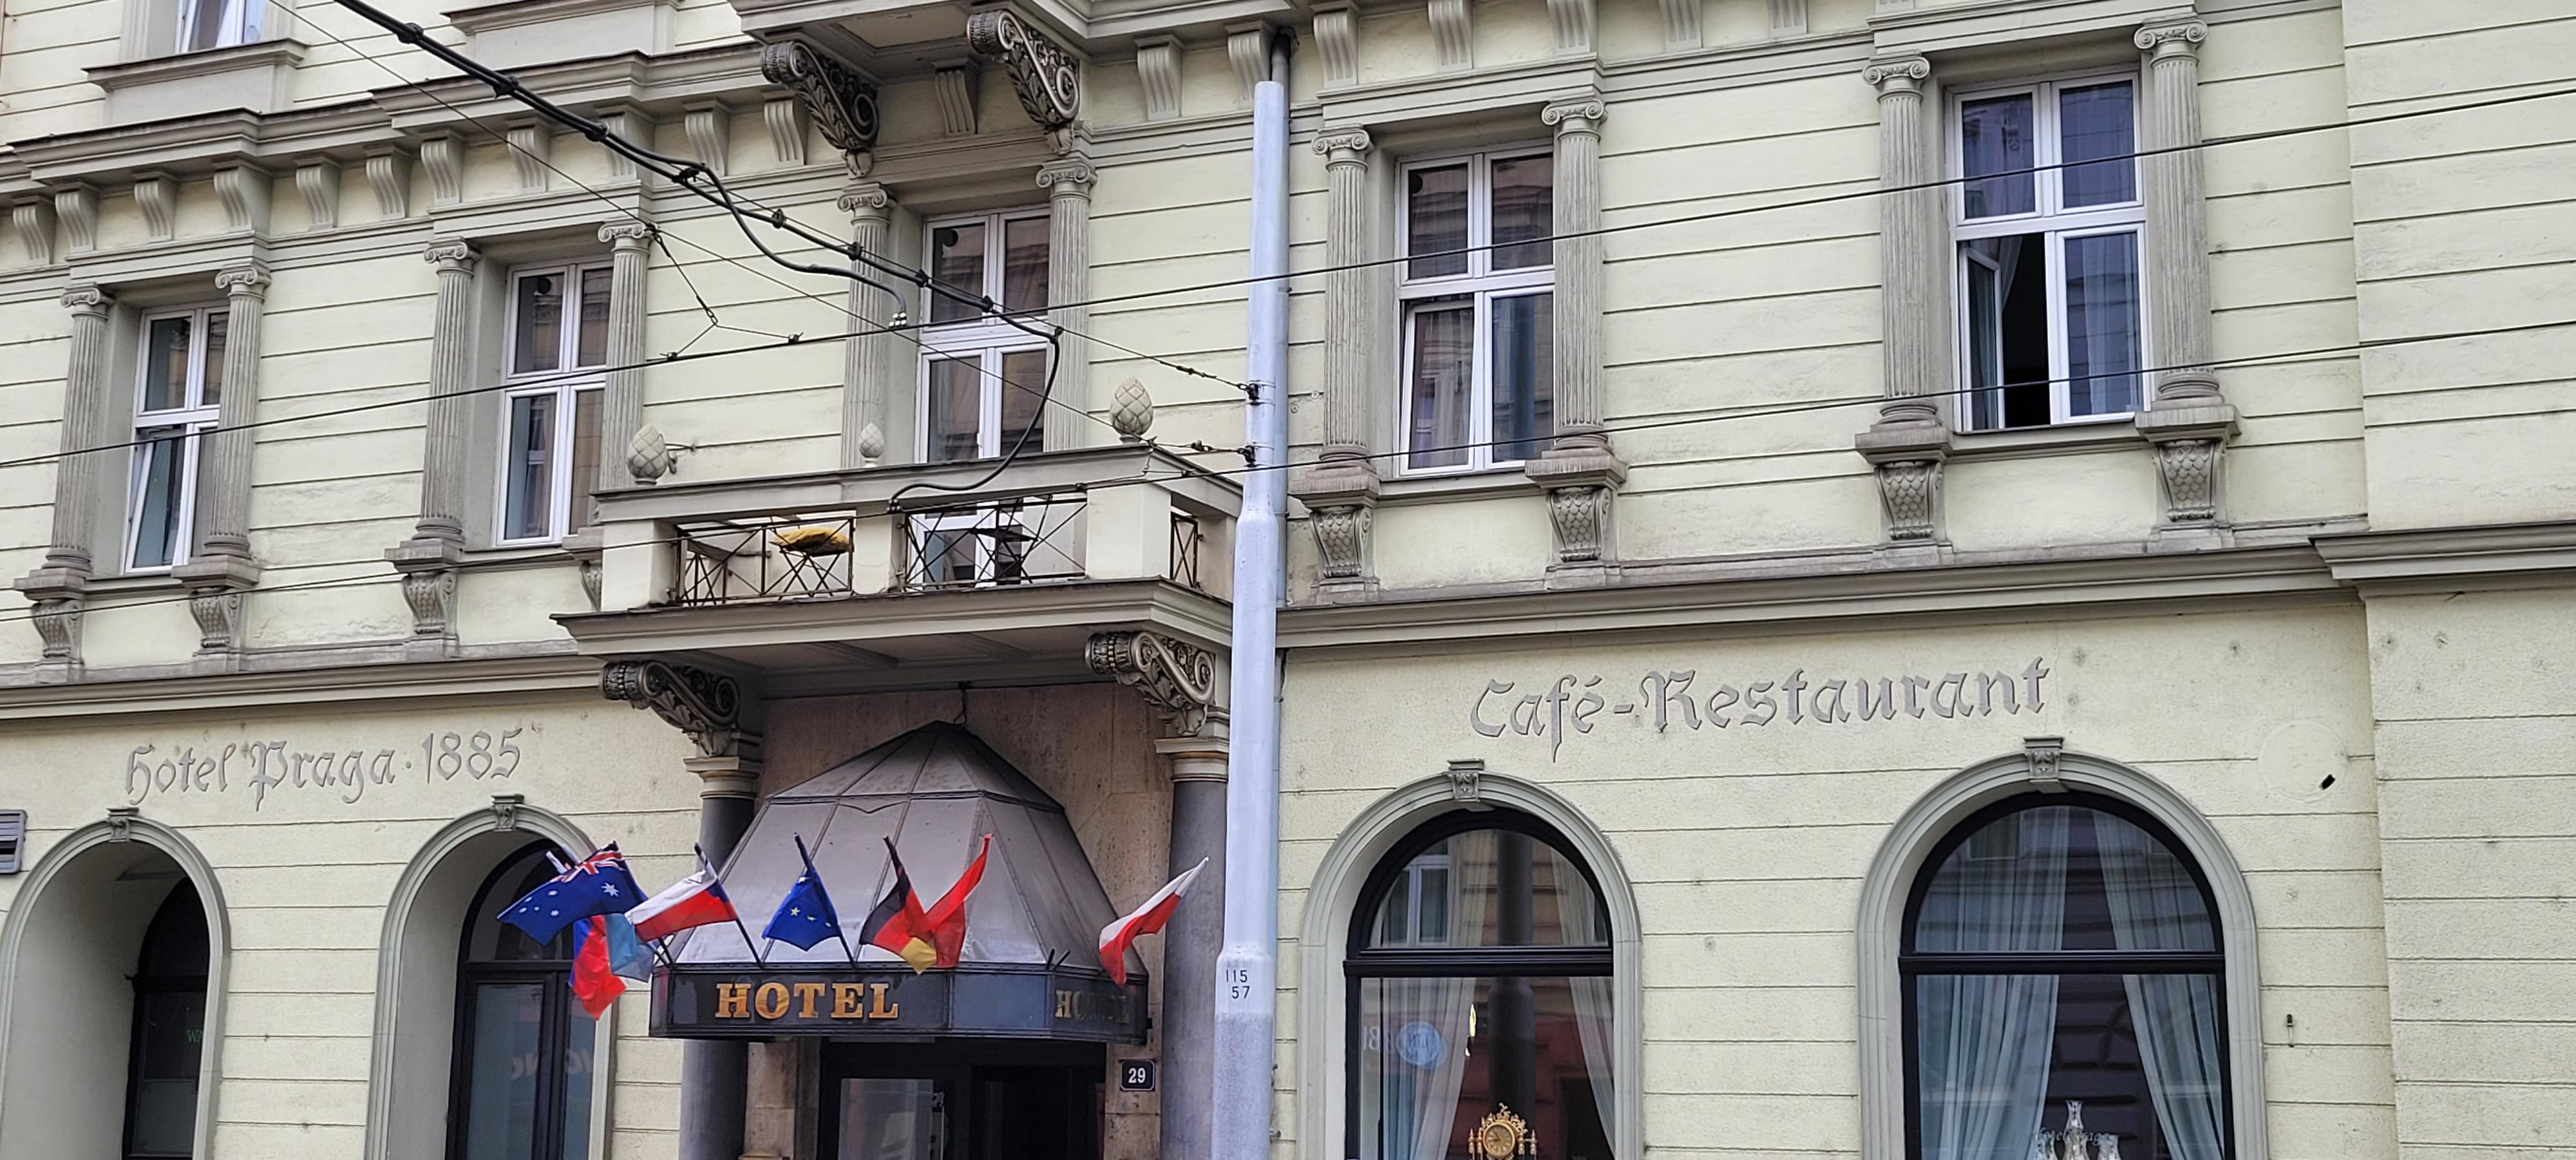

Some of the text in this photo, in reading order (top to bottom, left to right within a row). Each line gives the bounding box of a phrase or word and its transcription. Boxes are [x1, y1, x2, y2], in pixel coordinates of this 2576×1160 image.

[1470, 656, 2050, 763] Café-Restaurant
[249, 740, 395, 812] Praga
[421, 728, 522, 784] 1885
[1226, 969, 1248, 983] 115
[715, 982, 899, 1019] HOTEL
[1231, 985, 1251, 999] 57
[1128, 1067, 1146, 1083] 29
